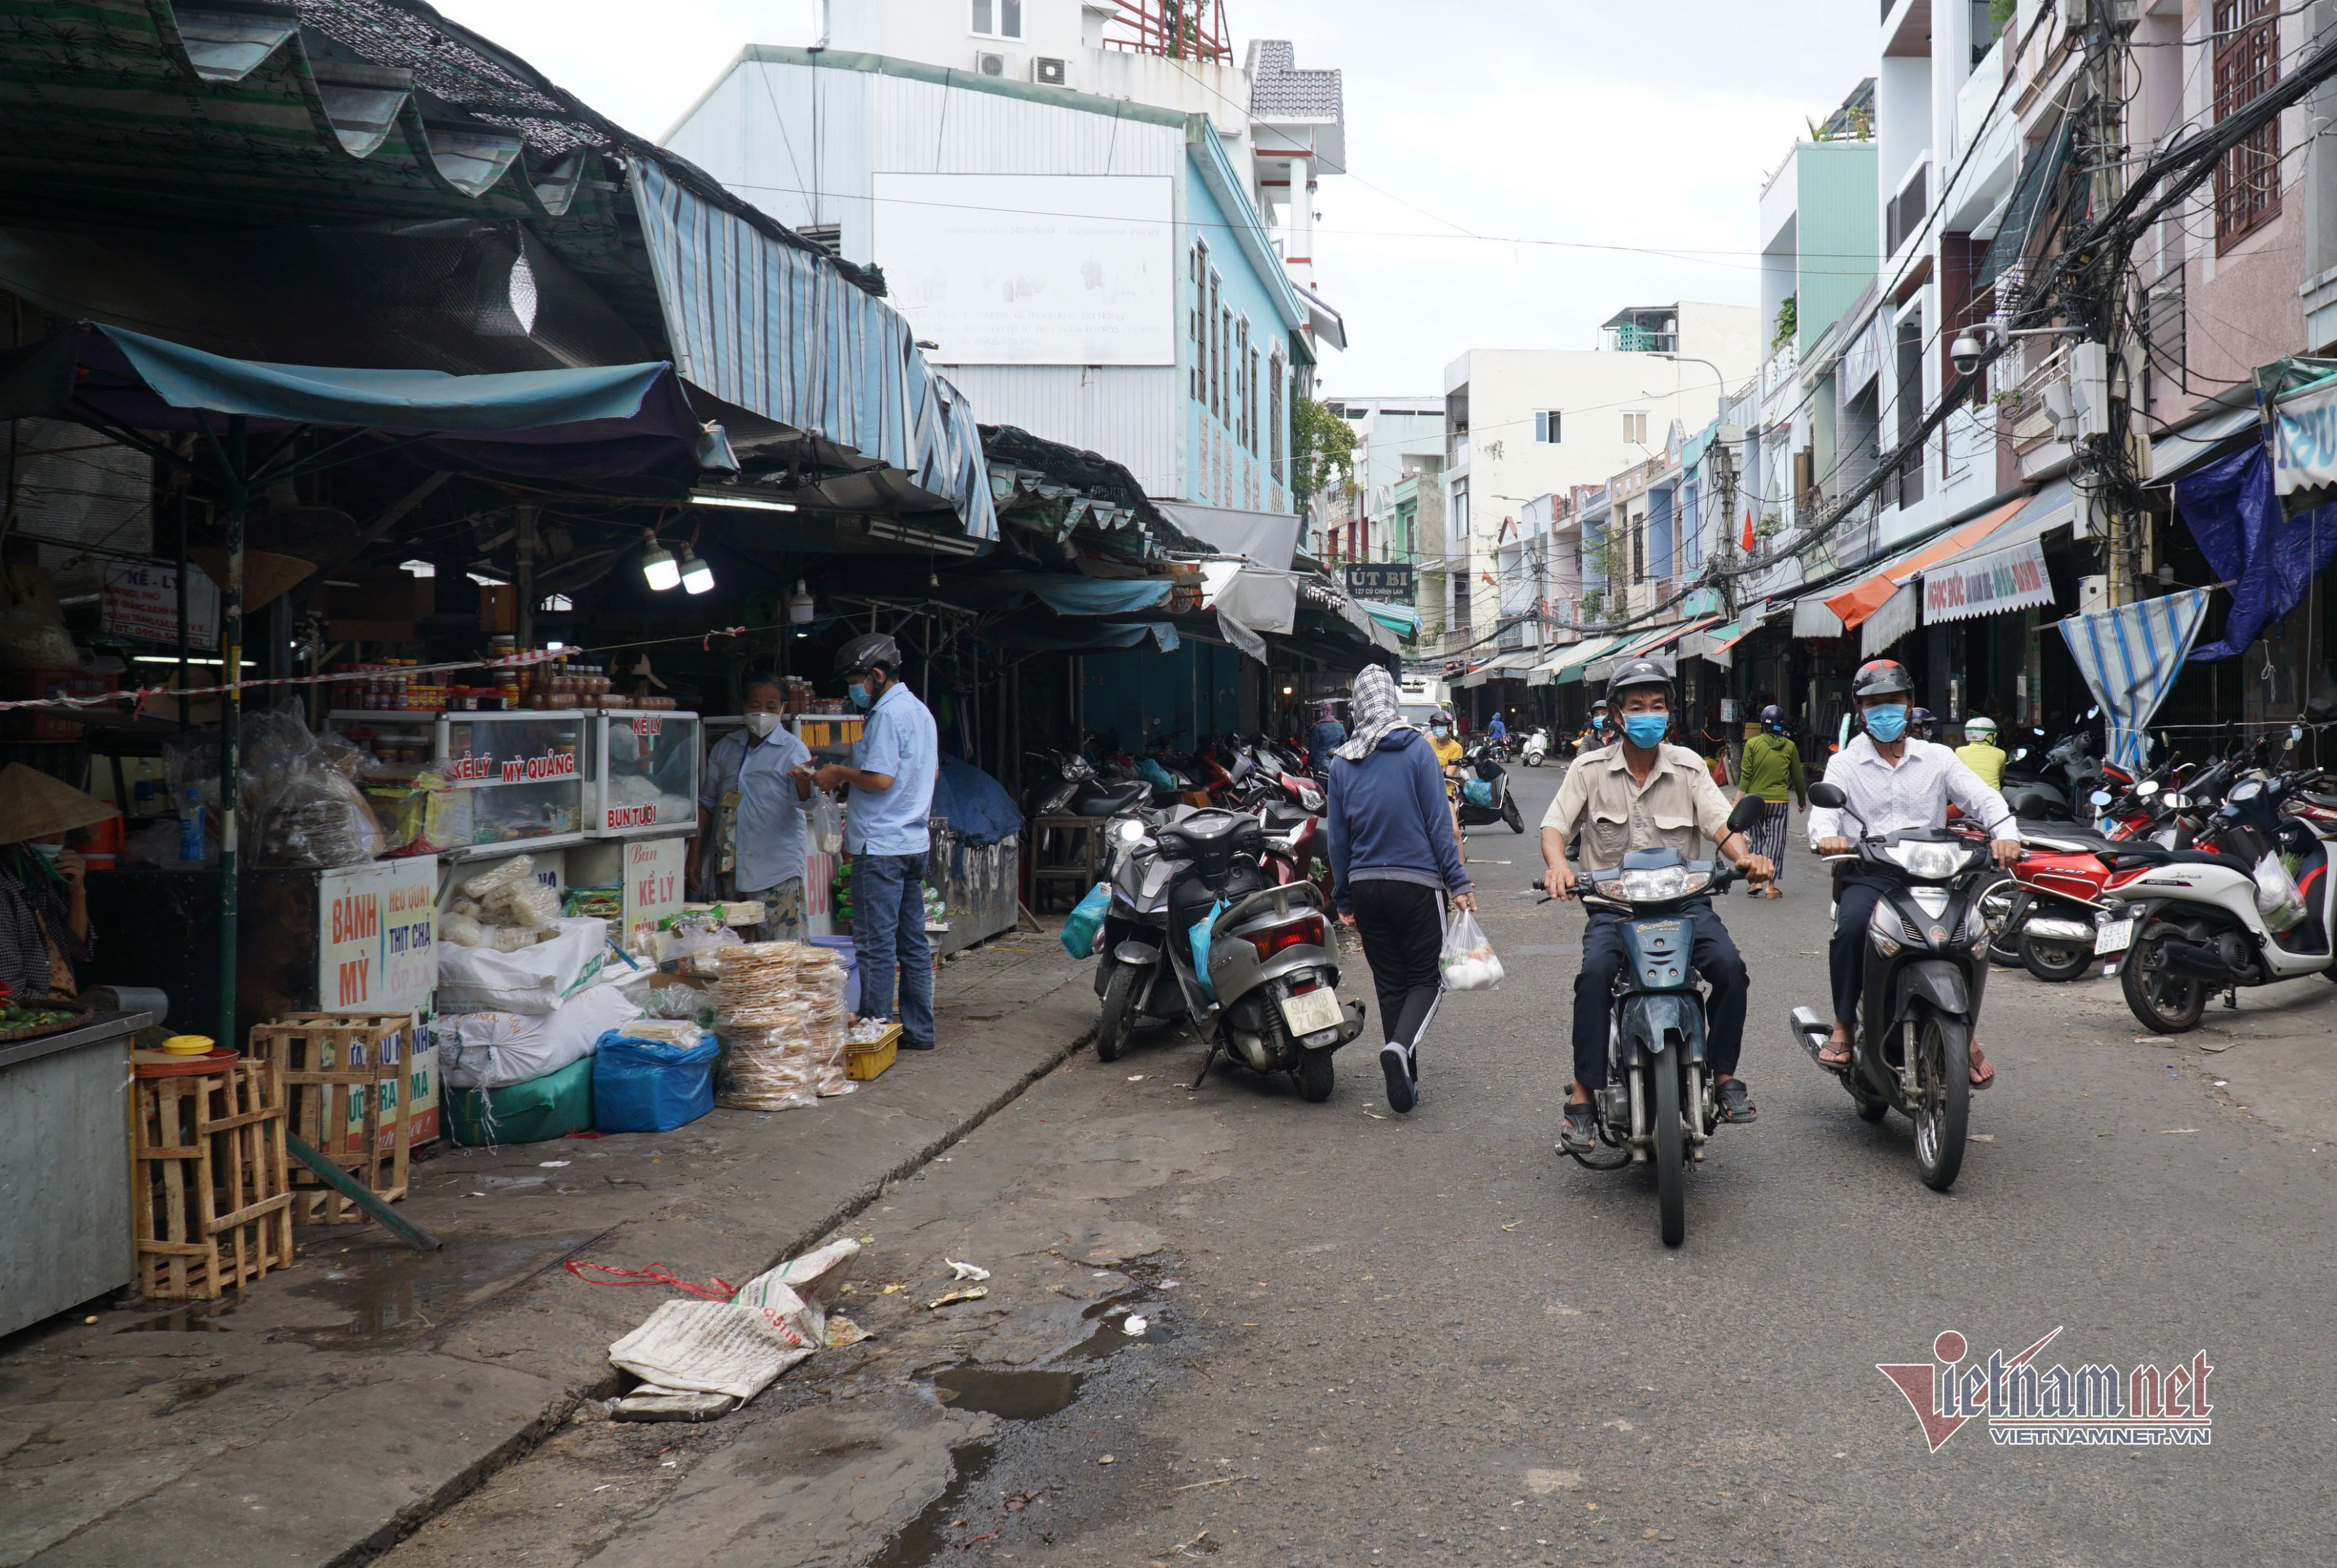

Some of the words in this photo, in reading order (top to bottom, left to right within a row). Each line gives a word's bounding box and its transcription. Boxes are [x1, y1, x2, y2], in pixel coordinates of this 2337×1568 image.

[1351, 567, 1381, 586] ÚT
[1386, 572, 1407, 586] BI
[633, 713, 648, 735] KỀ
[650, 714, 663, 735] LÝ
[474, 752, 492, 778] LÝ
[502, 755, 524, 783] MỲ
[527, 748, 575, 781] QUẢNG
[607, 801, 630, 829] BÚN
[632, 801, 658, 827] TƯƠI
[631, 844, 658, 864] Bún
[639, 871, 656, 907] KỀ
[660, 871, 674, 903] LÝ
[332, 887, 377, 945] BÁNH
[389, 925, 410, 957] THỊT
[412, 913, 431, 949] CHẢ
[339, 949, 370, 1007] MỲ
